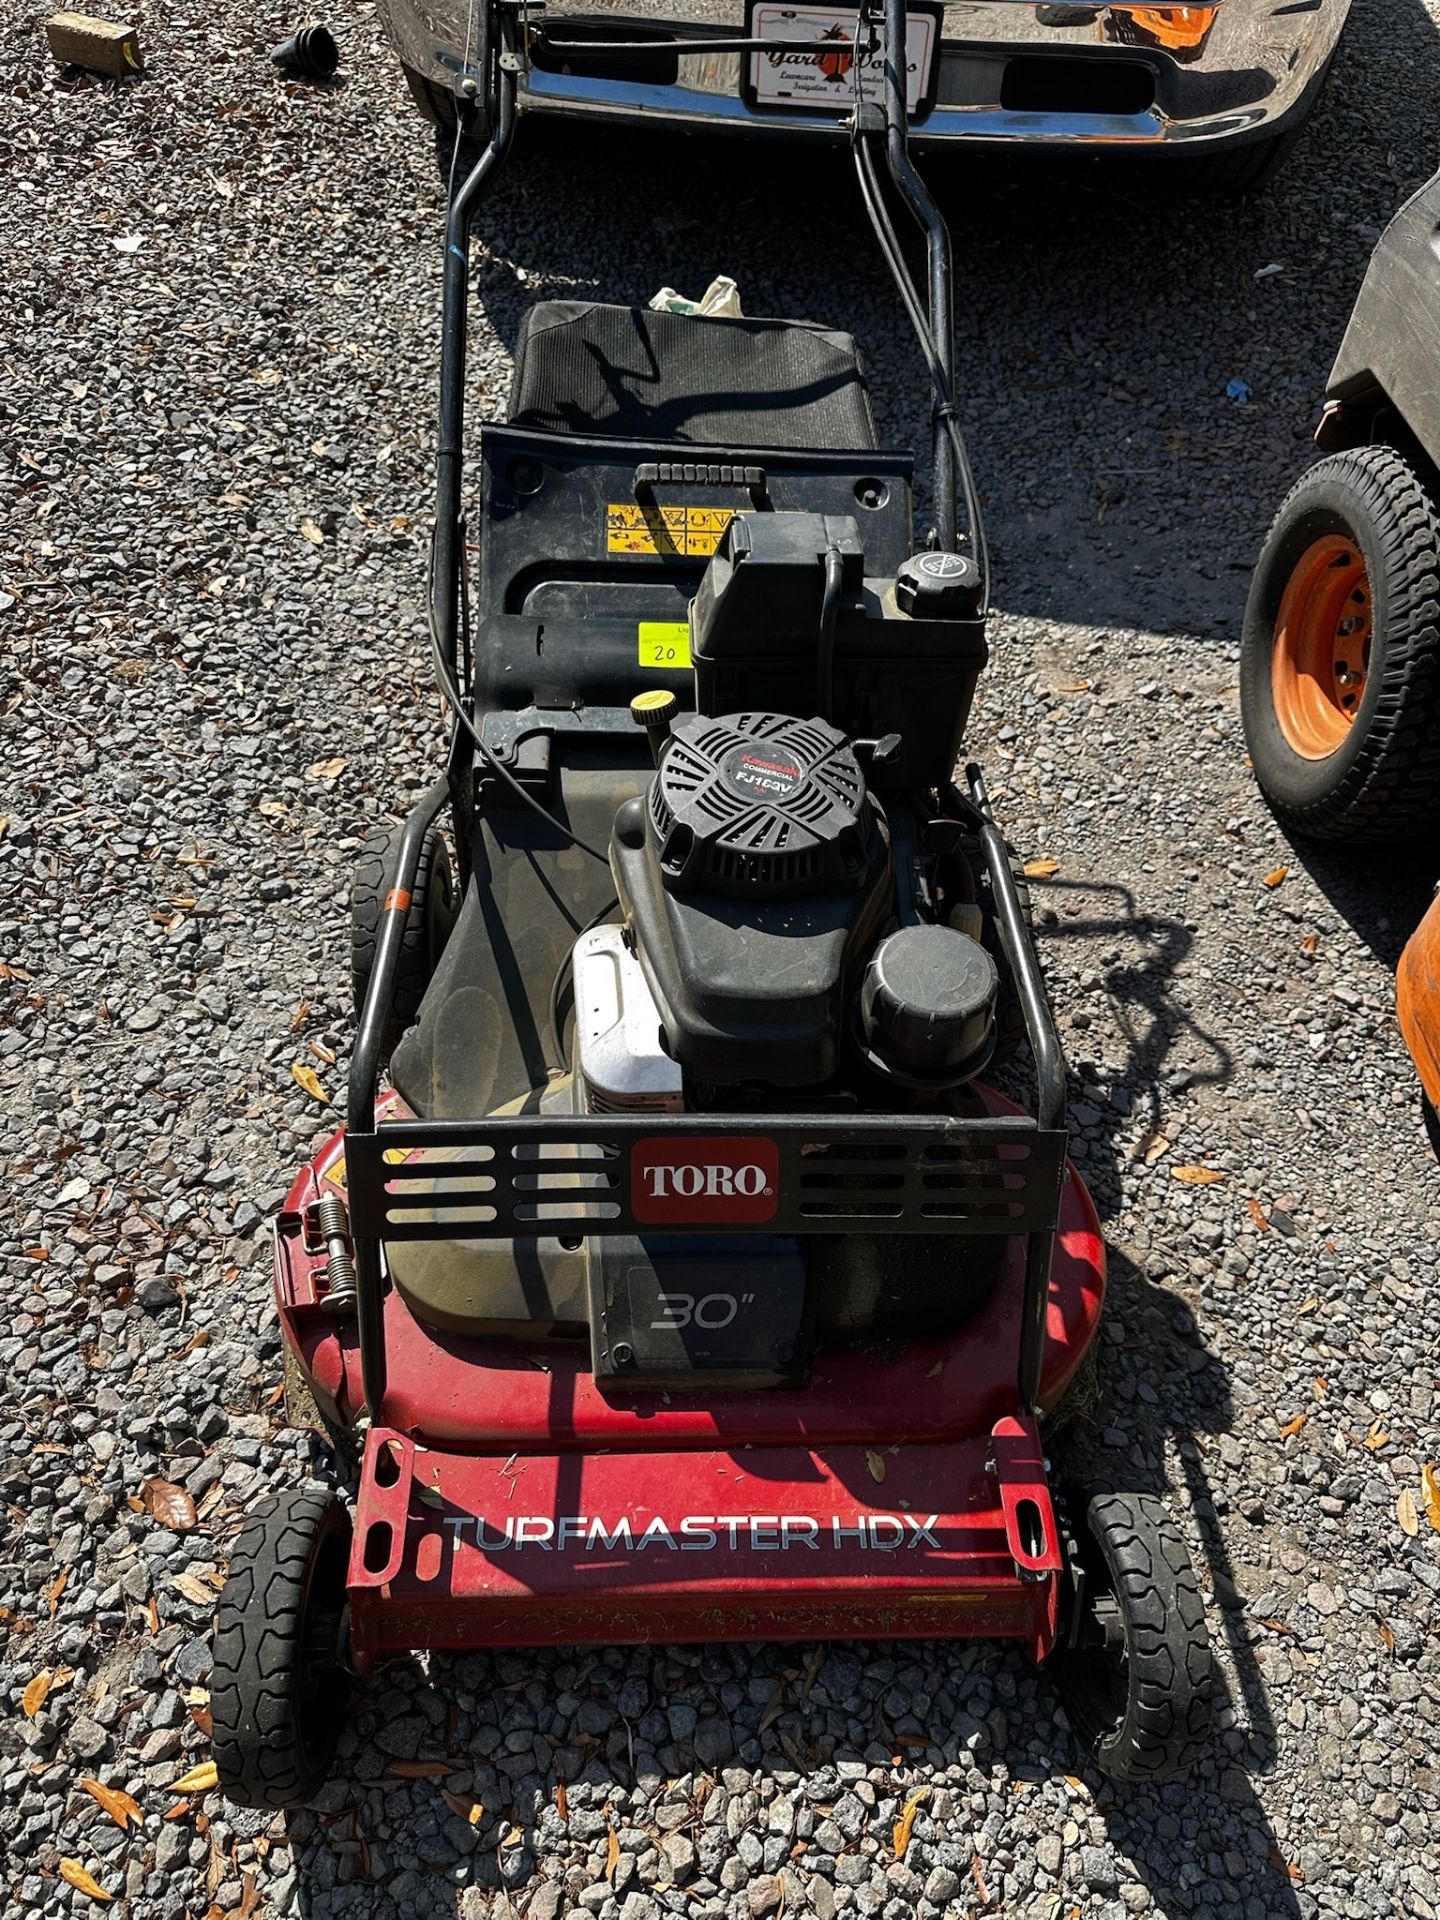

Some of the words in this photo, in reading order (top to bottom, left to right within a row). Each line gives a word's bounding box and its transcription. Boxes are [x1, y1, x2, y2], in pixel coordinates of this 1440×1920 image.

[848, 52, 917, 72] Wos
[780, 71, 816, 81] Lawncare
[834, 85, 841, 93] &
[653, 645, 676, 661] 20
[743, 763, 794, 782] COMMERCIAL
[442, 1513, 820, 1553] TURFMASTER
[832, 1513, 942, 1553] HDX
